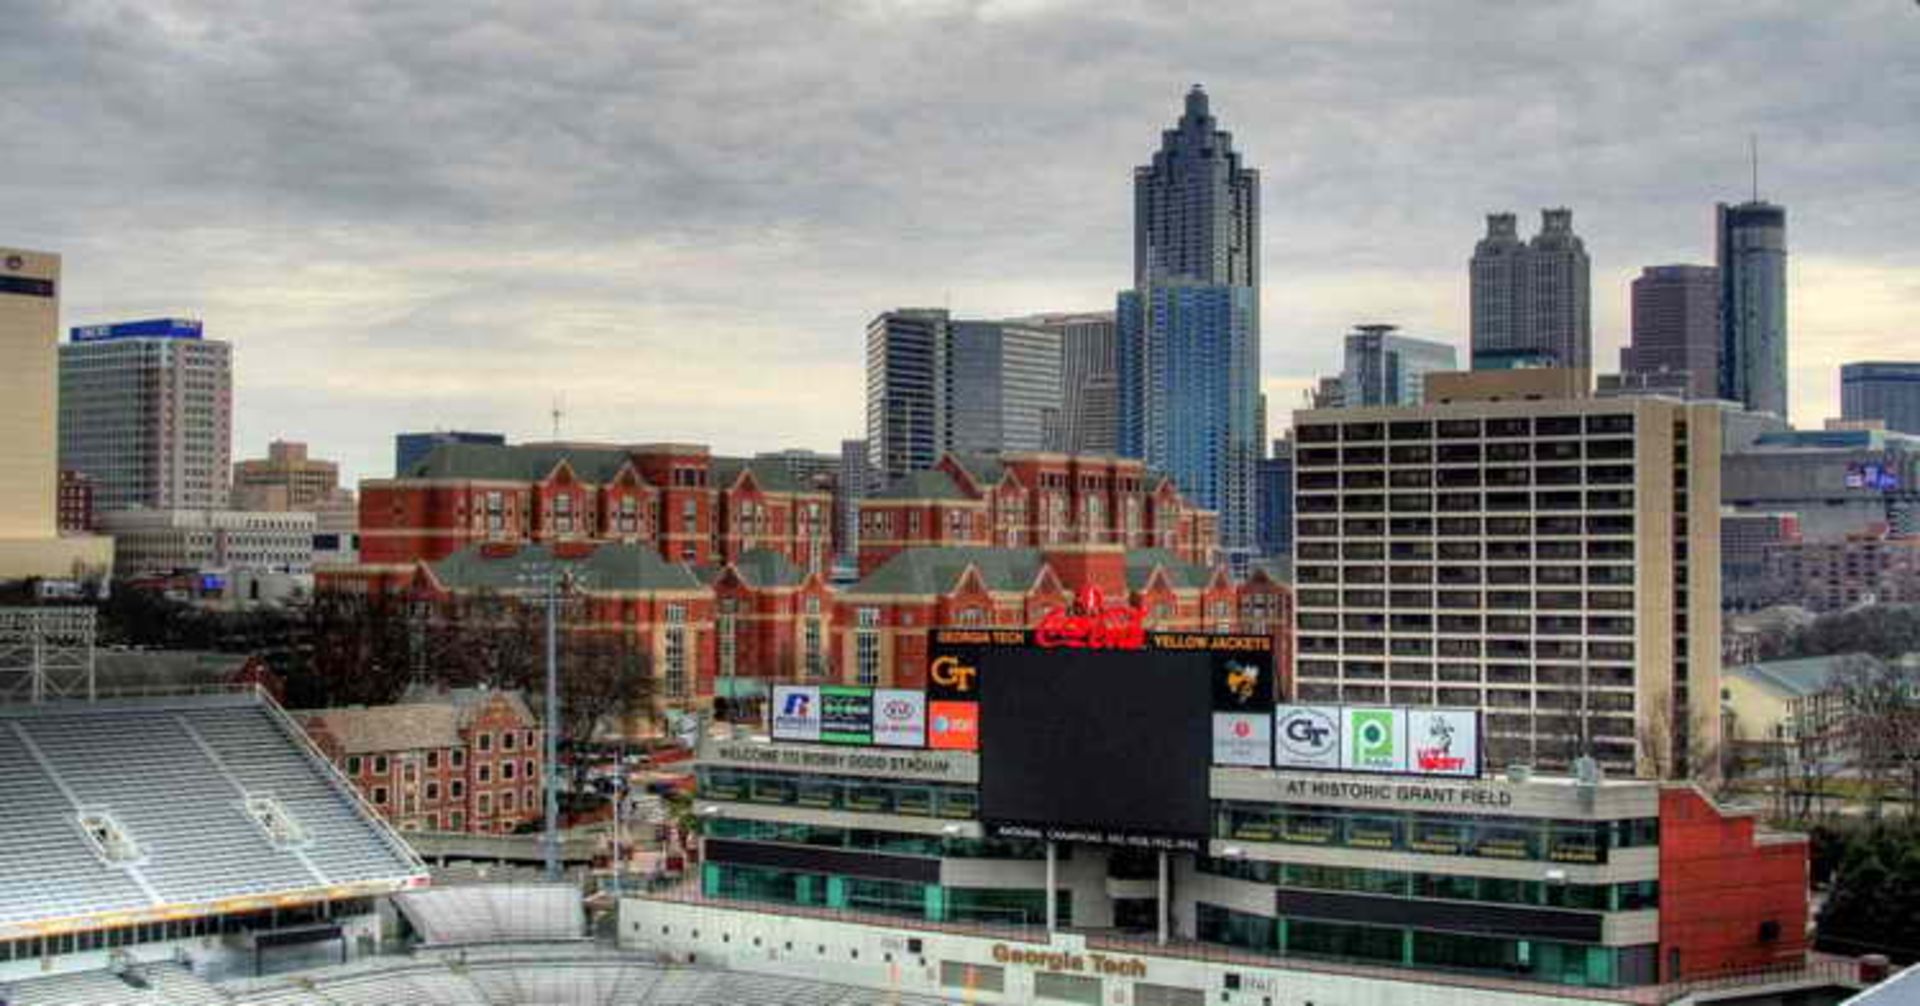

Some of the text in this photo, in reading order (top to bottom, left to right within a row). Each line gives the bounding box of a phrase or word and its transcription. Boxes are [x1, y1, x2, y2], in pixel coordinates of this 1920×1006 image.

[1154, 634, 1271, 651] YELLOW JACKETS
[931, 655, 977, 691] GT
[719, 746, 778, 762] WELCOME
[889, 757, 950, 773] STADIUM
[1286, 780, 1512, 806] AT HISTORIC GRANT FIELD
[992, 943, 1147, 978] Georgia Tech
